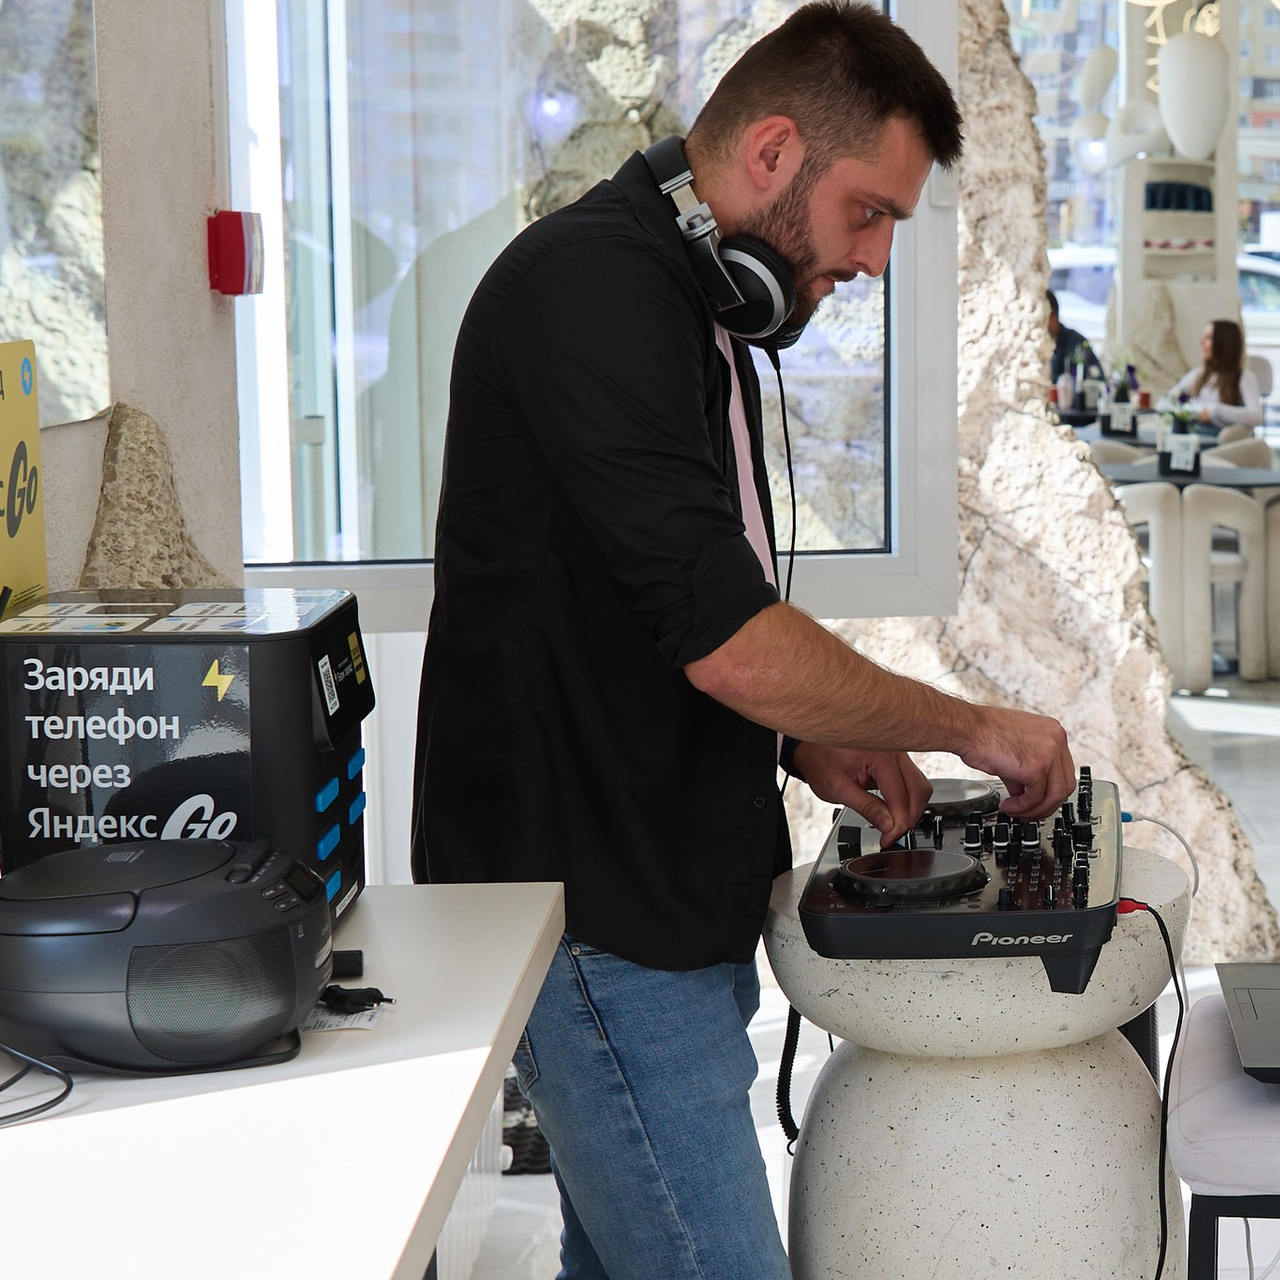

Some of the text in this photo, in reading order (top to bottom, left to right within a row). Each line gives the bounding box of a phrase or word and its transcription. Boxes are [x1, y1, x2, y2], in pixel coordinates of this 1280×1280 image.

[7, 440, 38, 539] Go
[23, 658, 154, 696] Заряди
[24, 707, 180, 743] телефон
[27, 763, 131, 790] через
[28, 794, 238, 842] Яндекс Go
[971, 932, 1074, 946] Pioneer
